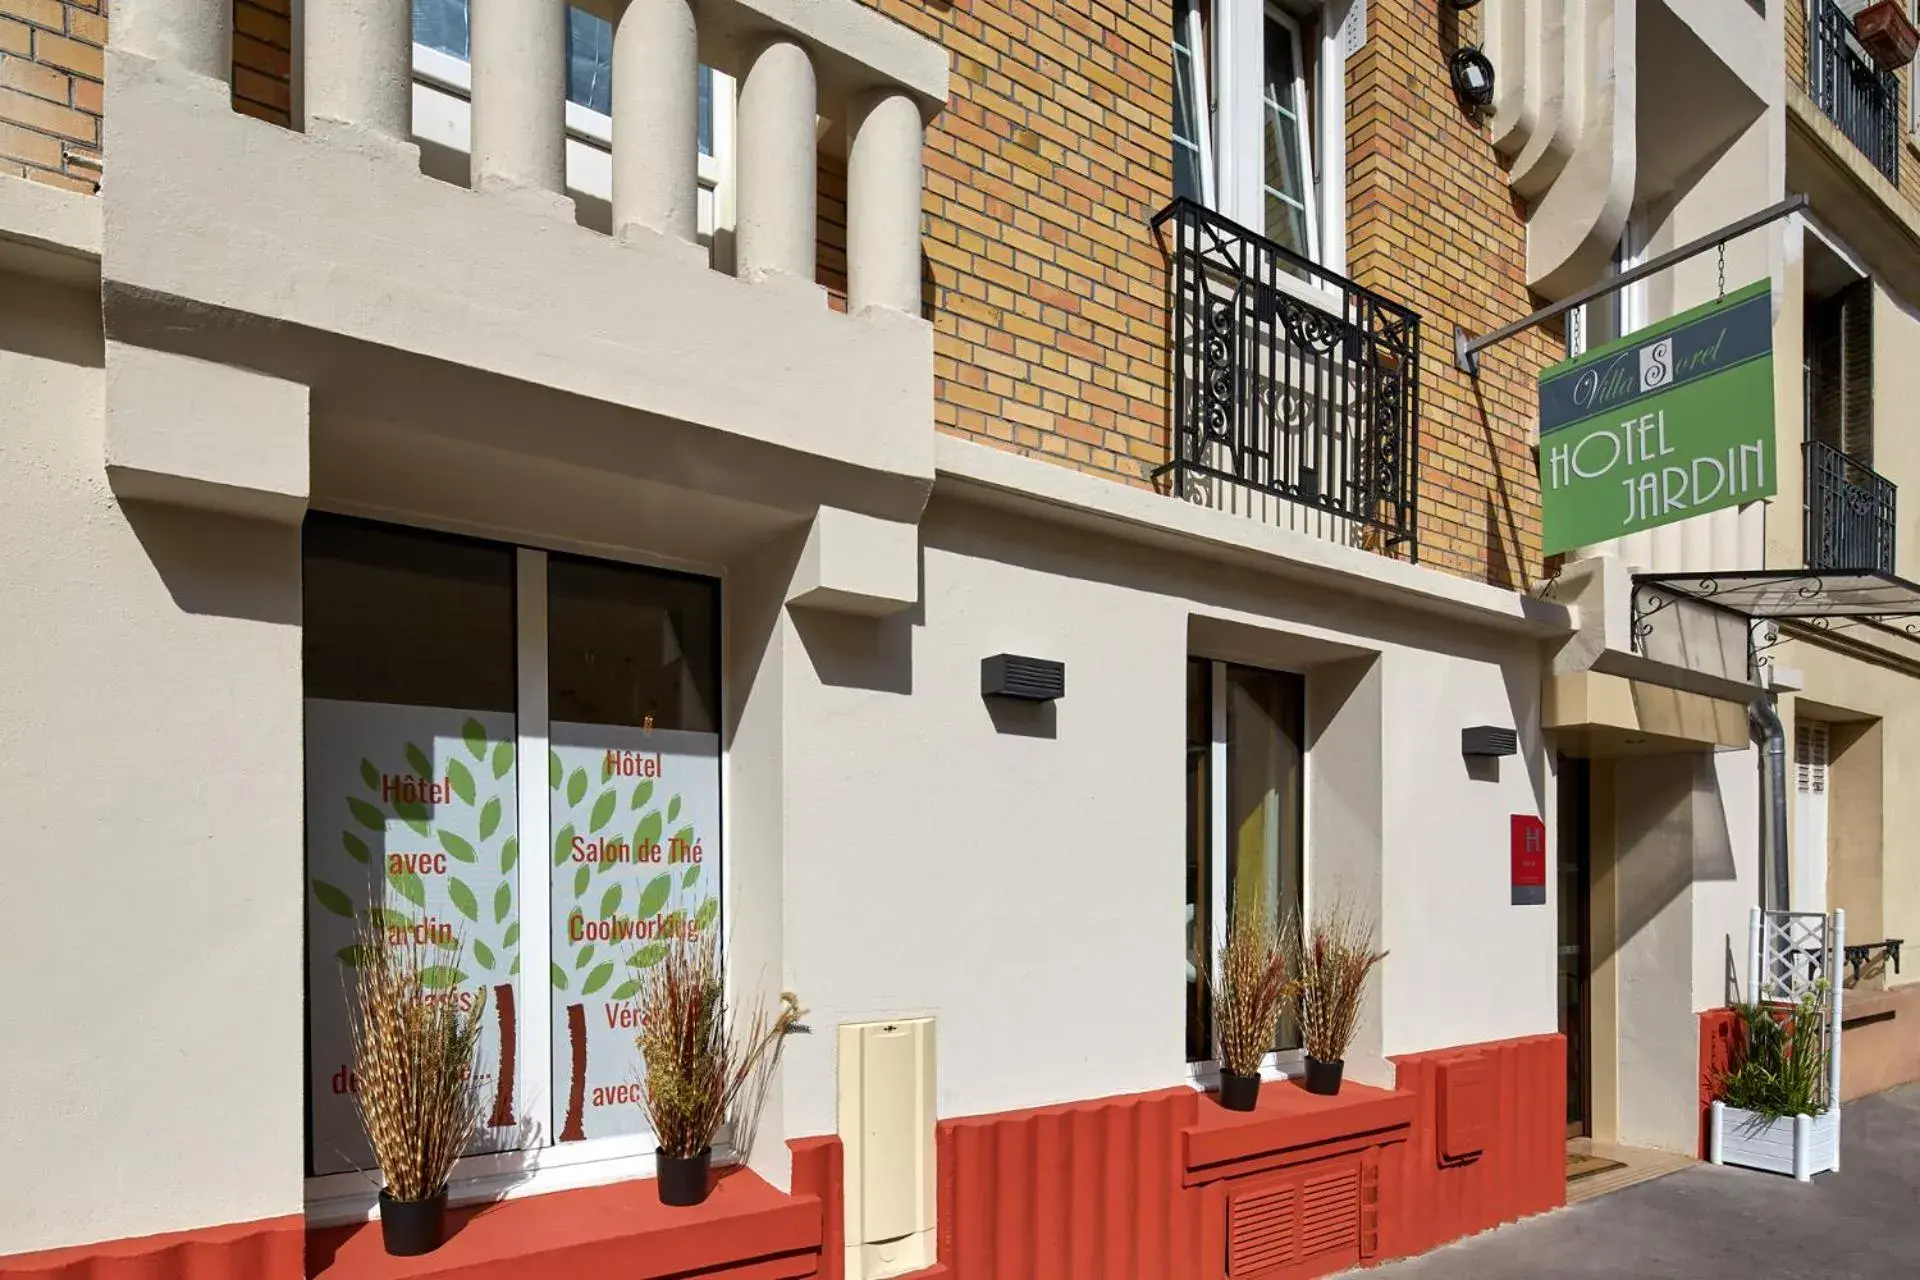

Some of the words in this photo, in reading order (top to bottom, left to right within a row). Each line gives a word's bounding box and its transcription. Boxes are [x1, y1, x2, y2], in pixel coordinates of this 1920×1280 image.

[1573, 352, 1635, 408] Villa
[1644, 328, 1727, 387] Sorel
[1550, 410, 1675, 489] HOTEL
[1622, 439, 1764, 525] JARDIN
[606, 751, 661, 777] Hôtel
[382, 773, 450, 804] Hôtel
[571, 836, 630, 863] Salon
[638, 838, 661, 863] de
[667, 838, 702, 863] Thé
[1525, 828, 1540, 853] H
[388, 853, 446, 875] avec
[386, 917, 452, 945] ardin
[592, 1083, 640, 1107] avec
